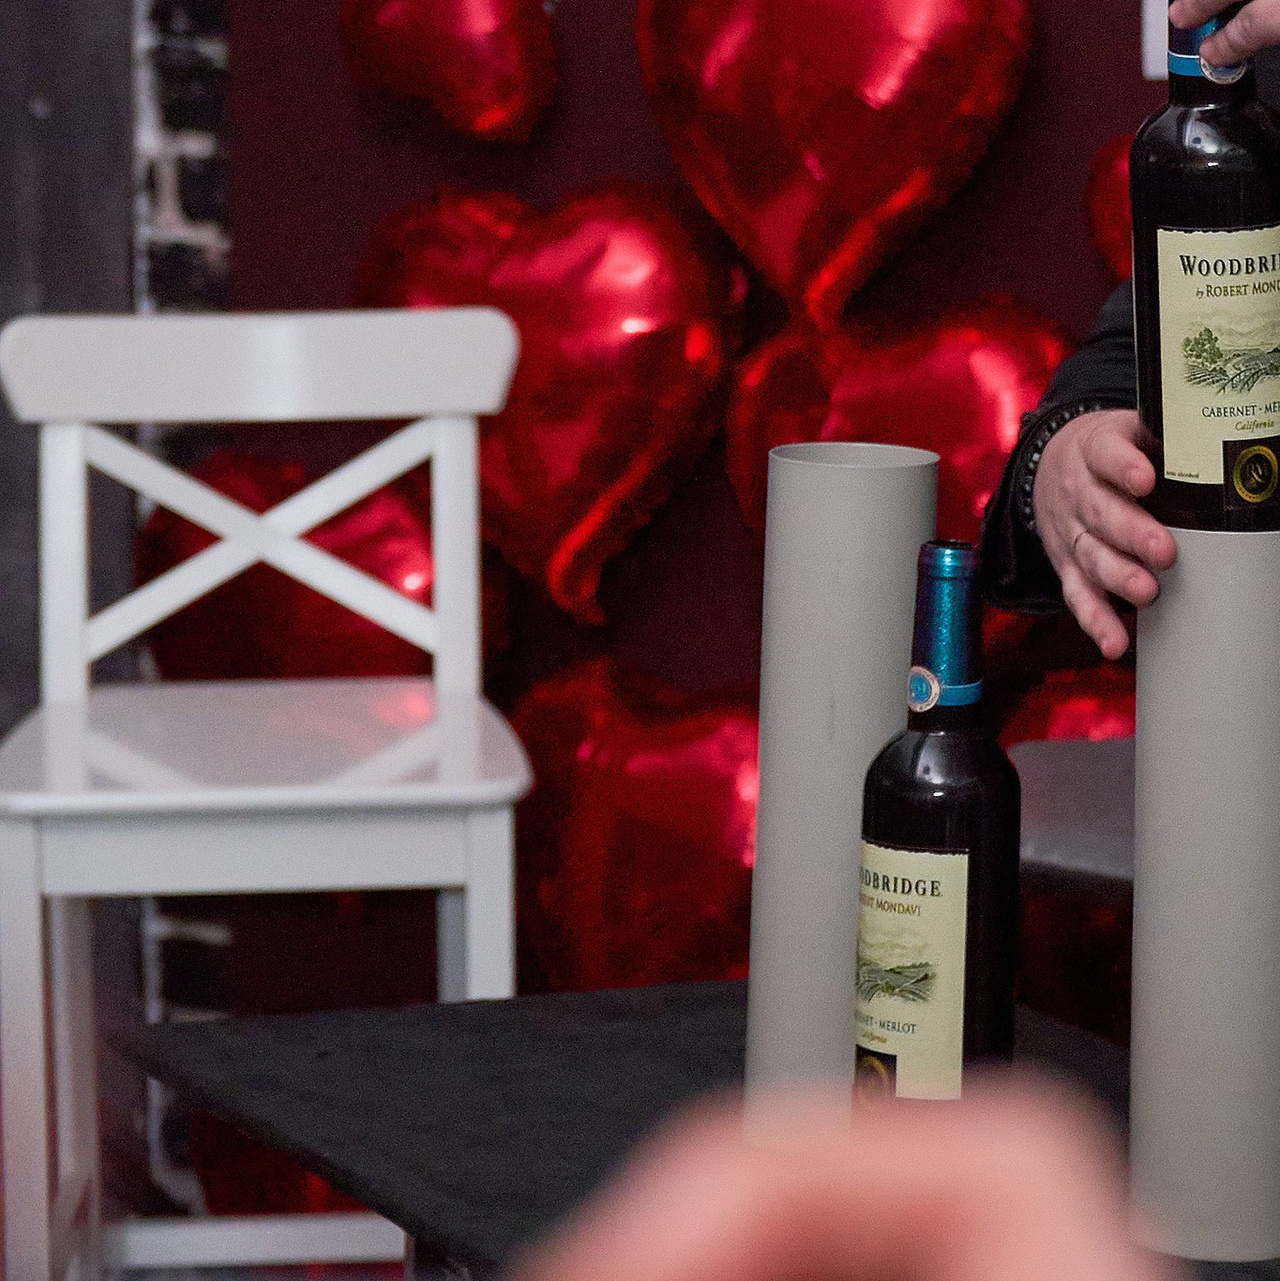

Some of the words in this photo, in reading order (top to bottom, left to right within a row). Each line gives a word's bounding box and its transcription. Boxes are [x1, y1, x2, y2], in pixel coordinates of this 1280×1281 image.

[1205, 283, 1249, 298] ROBERT
[1201, 404, 1258, 418] CABERNET
[1234, 419, 1276, 433] California
[875, 898, 921, 917] MONDAVI
[879, 1019, 917, 1035] MERLOT
